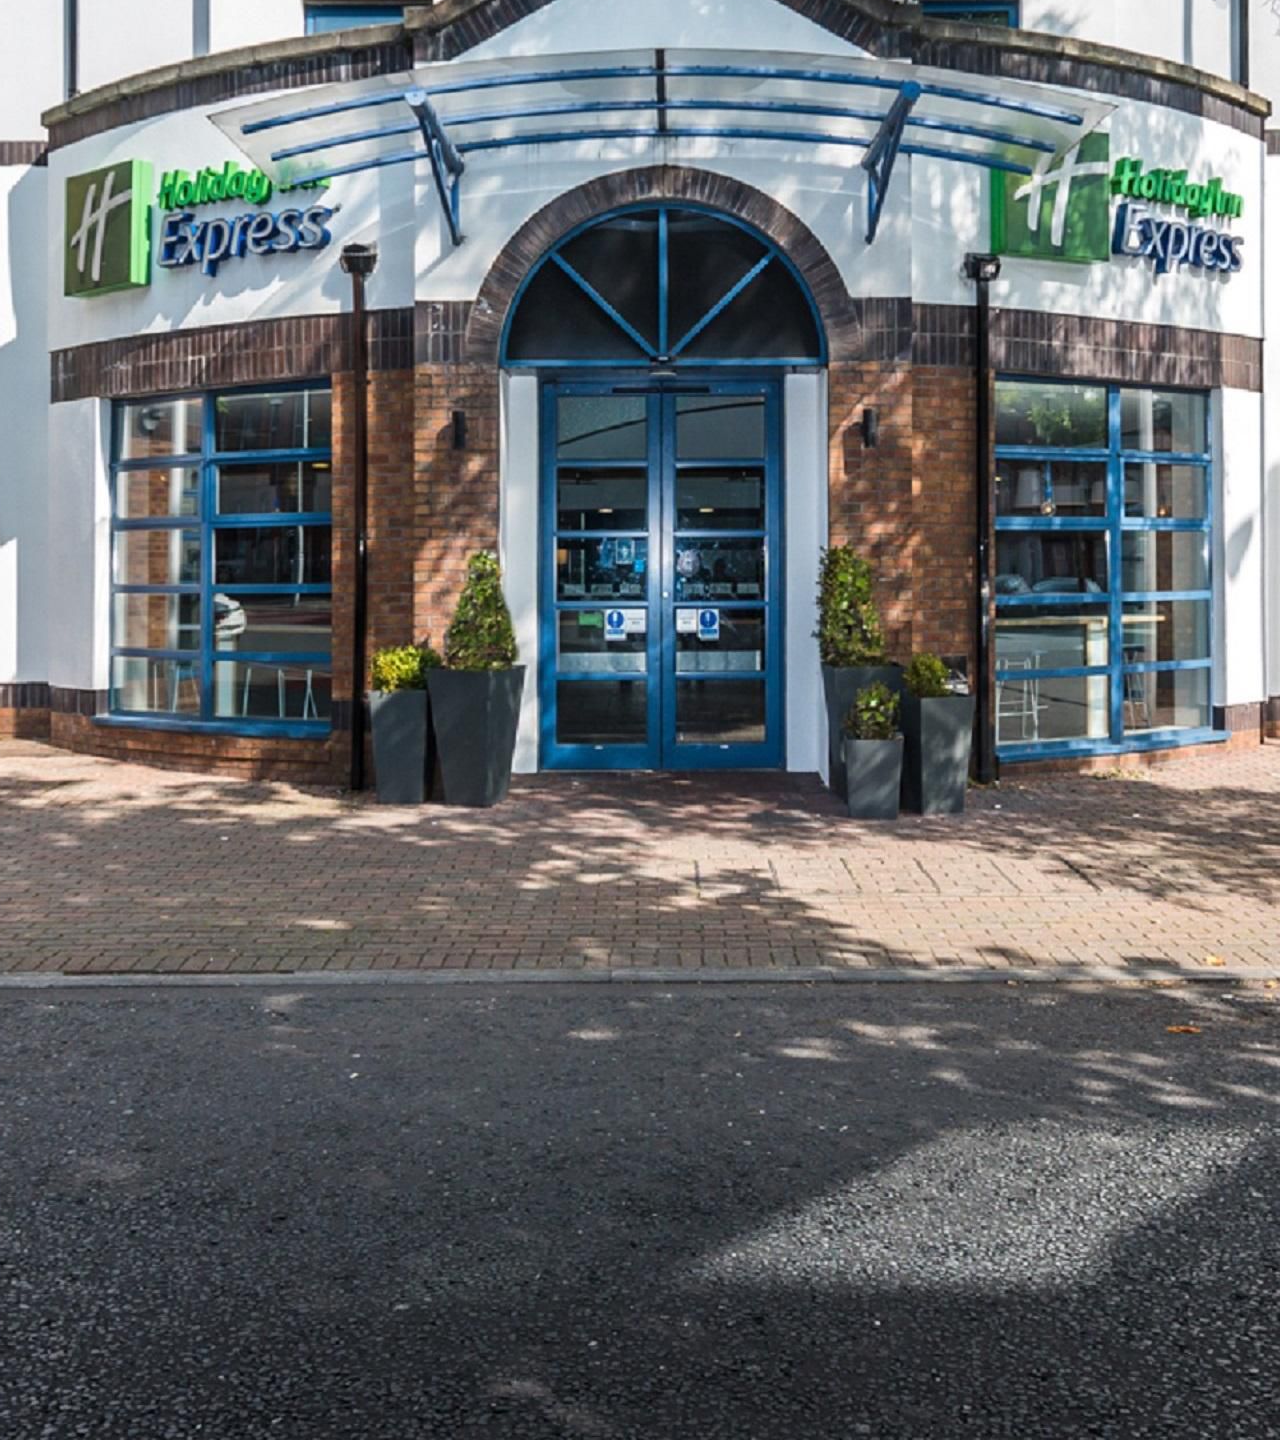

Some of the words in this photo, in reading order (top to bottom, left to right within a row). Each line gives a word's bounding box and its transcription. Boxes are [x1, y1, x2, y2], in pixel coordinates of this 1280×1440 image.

[158, 161, 272, 209] Holiday
[1111, 157, 1213, 218] Holiday
[1209, 177, 1243, 218] Inn
[158, 206, 333, 277] Express
[1111, 202, 1245, 274] Express
